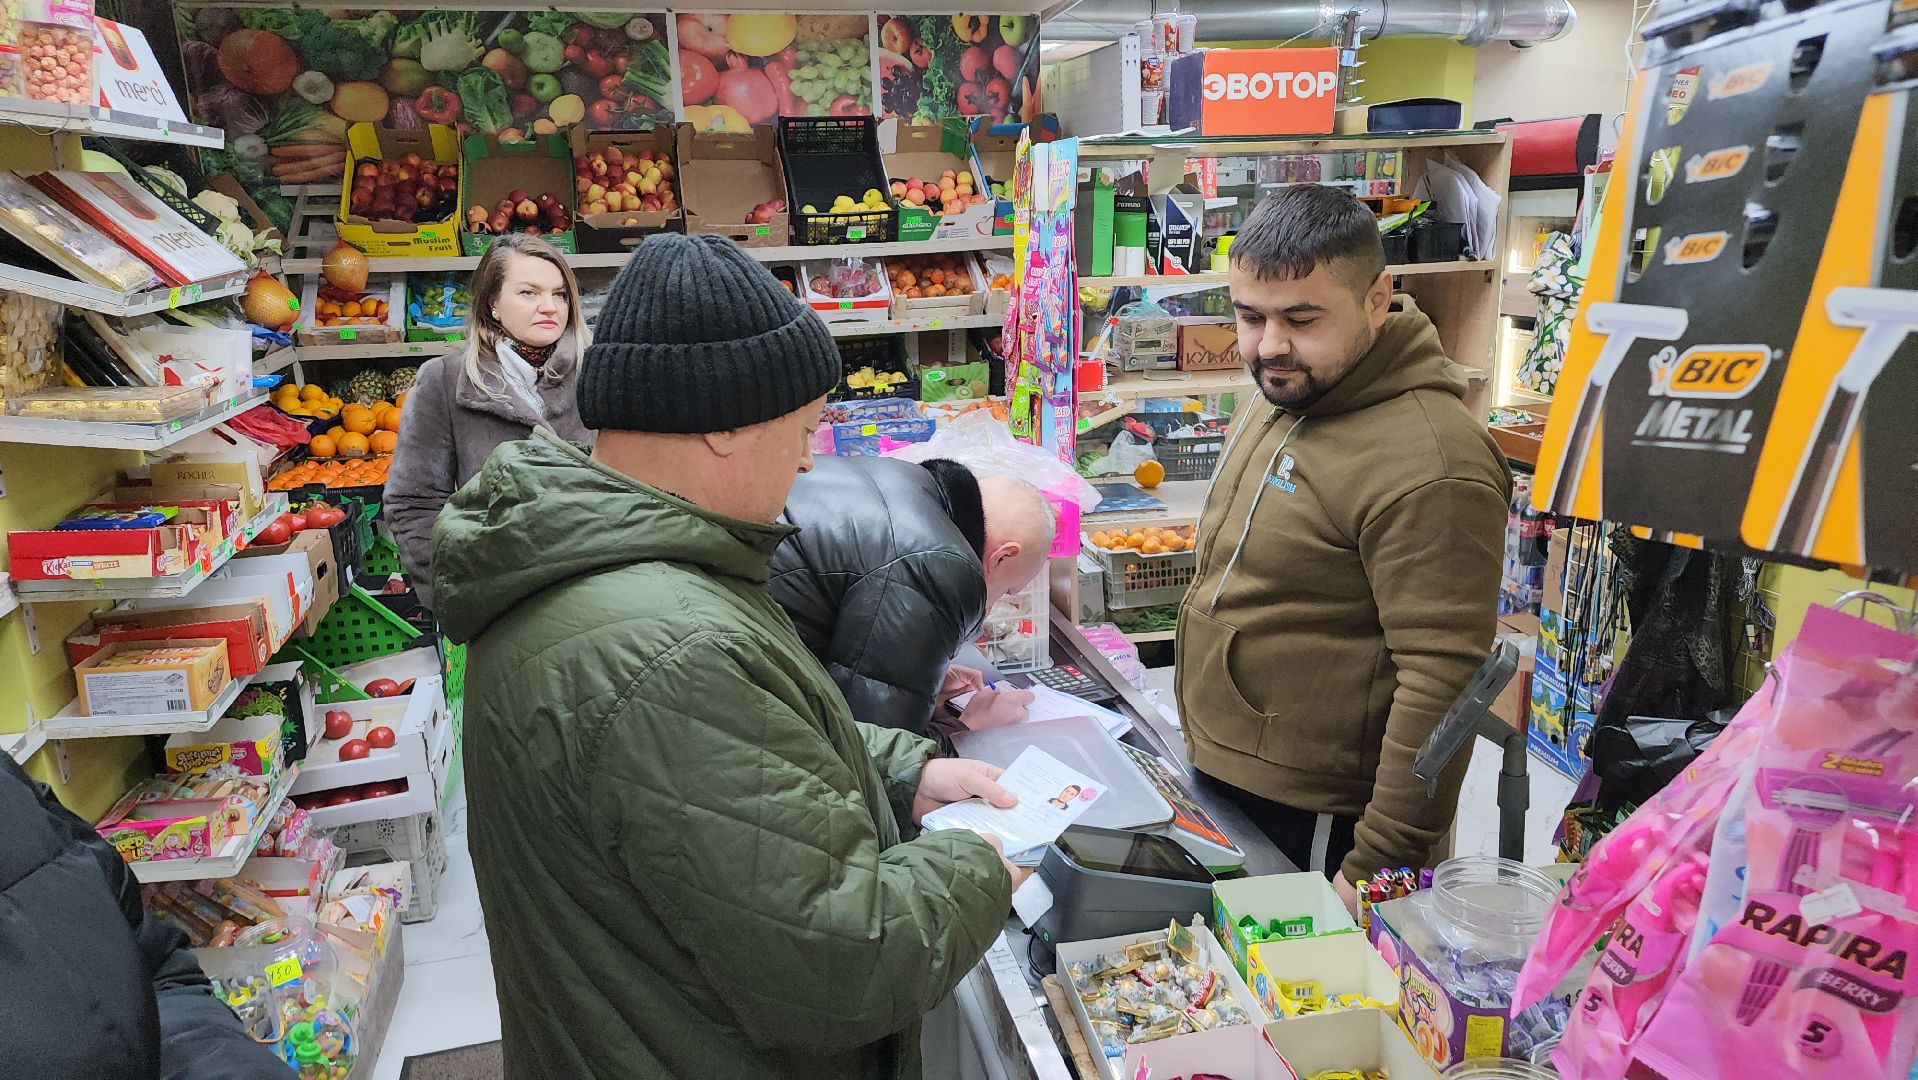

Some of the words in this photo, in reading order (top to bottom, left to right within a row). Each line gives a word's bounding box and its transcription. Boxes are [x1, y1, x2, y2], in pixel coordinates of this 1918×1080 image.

[115, 79, 167, 106] merci
[1203, 71, 1337, 101] ЭВОТОР
[412, 236, 451, 245] Muslim
[1633, 400, 1754, 444] METAL
[177, 470, 217, 481] ROCHER
[95, 561, 119, 570] WHITE
[1538, 669, 1567, 691] PREMIUM
[1531, 743, 1559, 767] PREMIUM
[1738, 900, 1907, 980] RAPIRA
[270, 964, 292, 981] 150
[1815, 972, 1888, 1007] BERRY
[1801, 1020, 1833, 1044] 5
